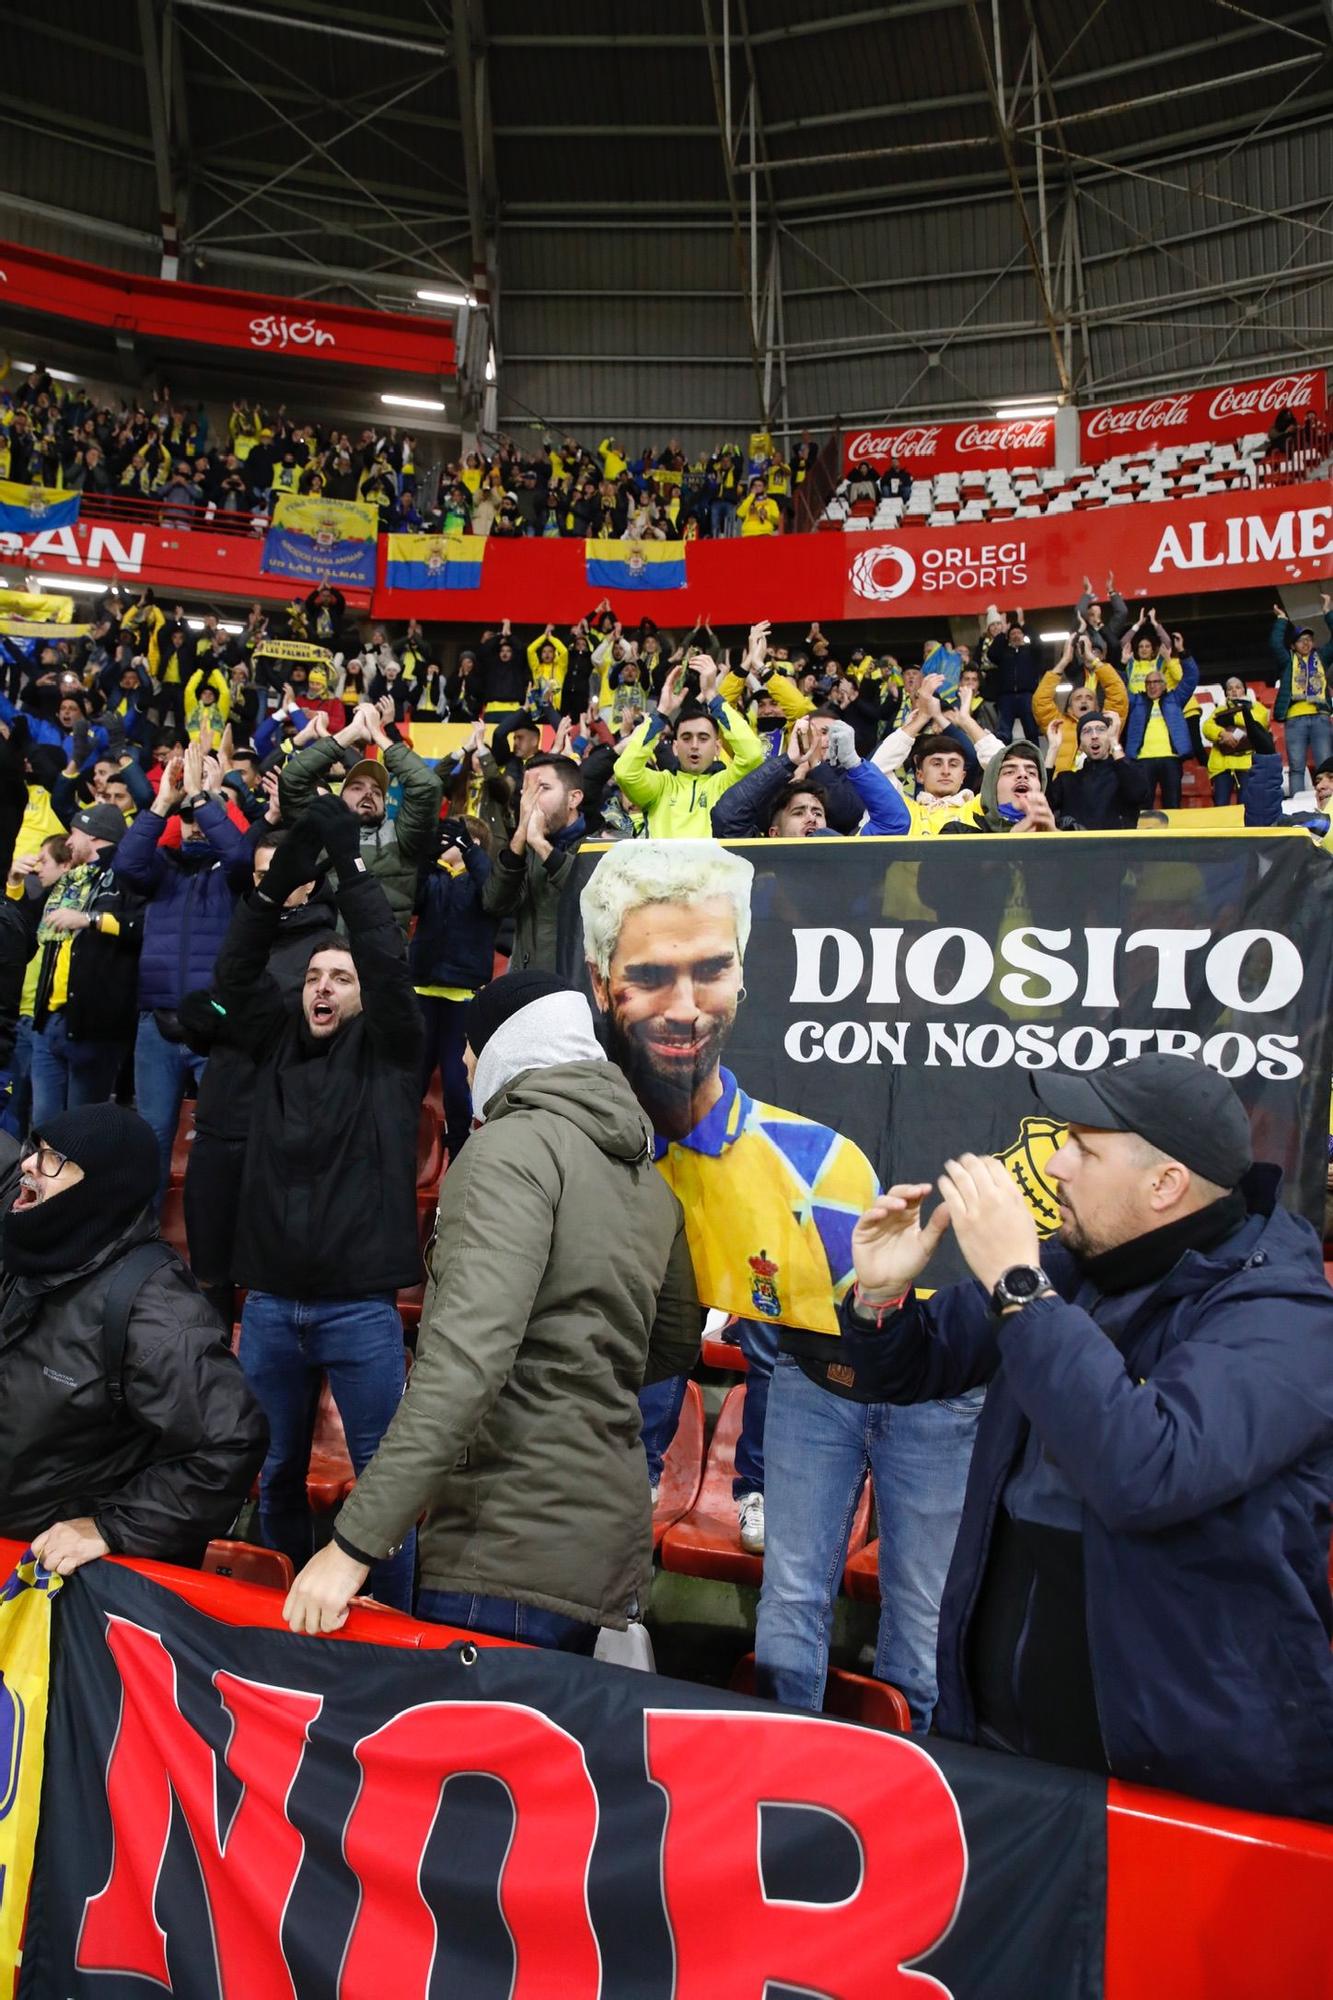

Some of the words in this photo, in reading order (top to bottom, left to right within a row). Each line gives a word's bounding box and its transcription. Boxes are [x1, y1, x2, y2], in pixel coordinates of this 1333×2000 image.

[249, 315, 335, 348] gijón
[922, 542, 1026, 568] ORLEGI
[1149, 506, 1333, 573] ALIME
[269, 559, 285, 567] UD
[288, 563, 312, 574] LAS
[921, 564, 1028, 591] SPORTS
[789, 926, 1304, 1013] DIOSITO
[784, 1021, 911, 1064] CON
[924, 1022, 1304, 1081] NOSOTROS
